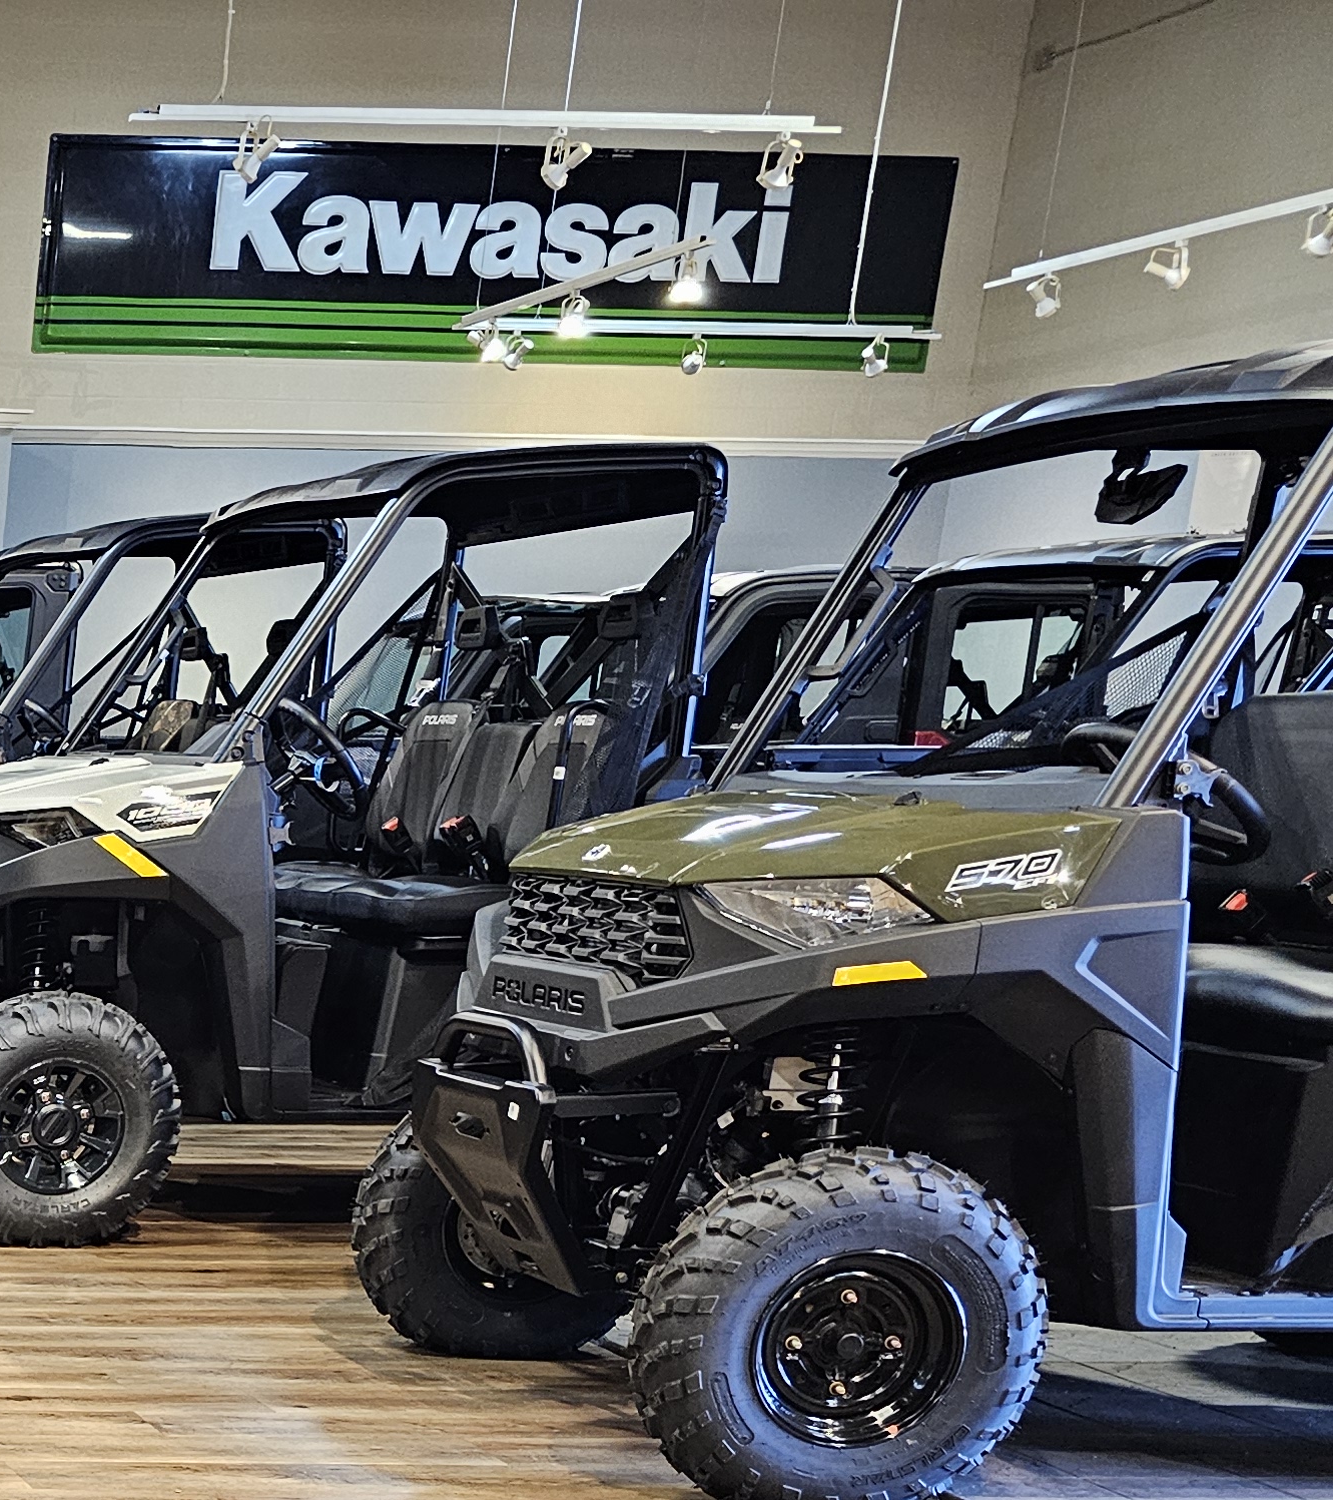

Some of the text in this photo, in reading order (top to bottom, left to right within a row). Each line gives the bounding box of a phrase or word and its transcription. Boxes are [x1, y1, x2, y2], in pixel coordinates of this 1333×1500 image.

[209, 170, 795, 285] Kawasaki
[422, 714, 458, 726] POLARIS
[554, 714, 597, 727] PARIS
[944, 848, 1063, 893] 570
[492, 975, 585, 1016] POLARIS
